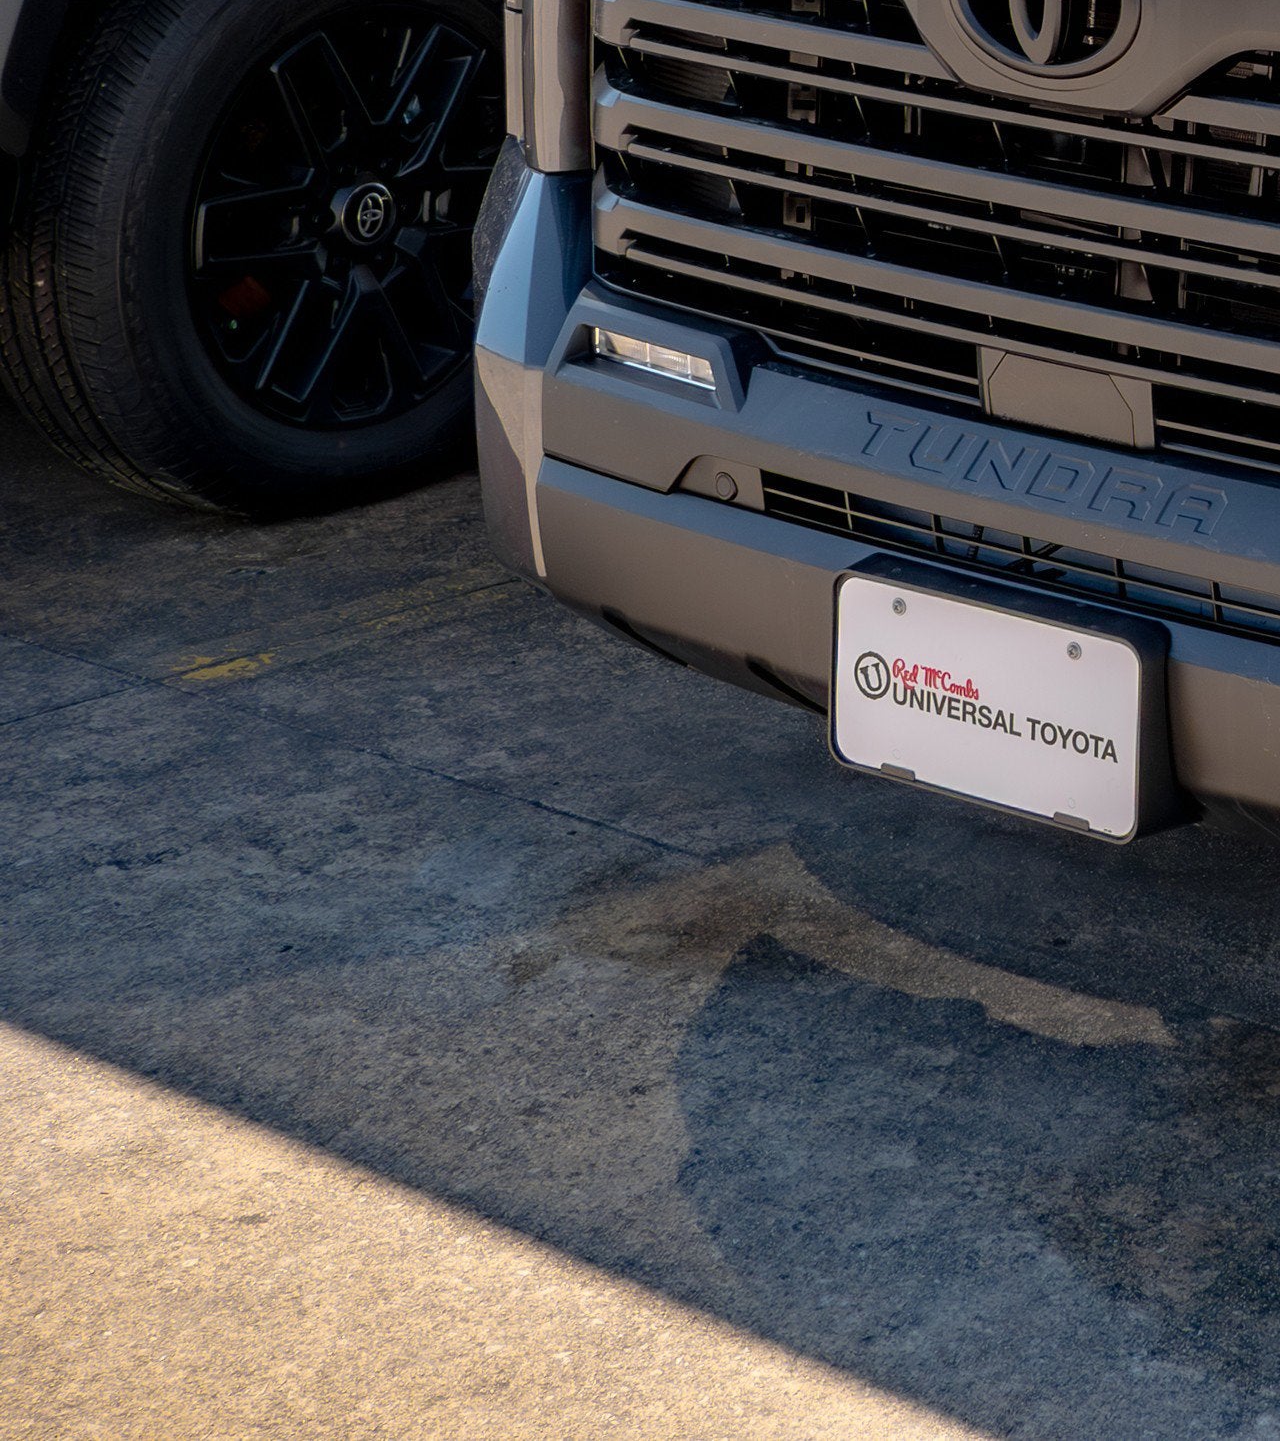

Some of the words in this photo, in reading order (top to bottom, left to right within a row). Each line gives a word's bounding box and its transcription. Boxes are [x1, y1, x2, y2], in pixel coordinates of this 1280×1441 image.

[861, 409, 1230, 536] TUNDRA
[892, 658, 919, 690] Red
[921, 665, 980, 701] McCombs
[893, 682, 1022, 738] UNIVERSAL
[1026, 716, 1119, 764] TOYOTA
